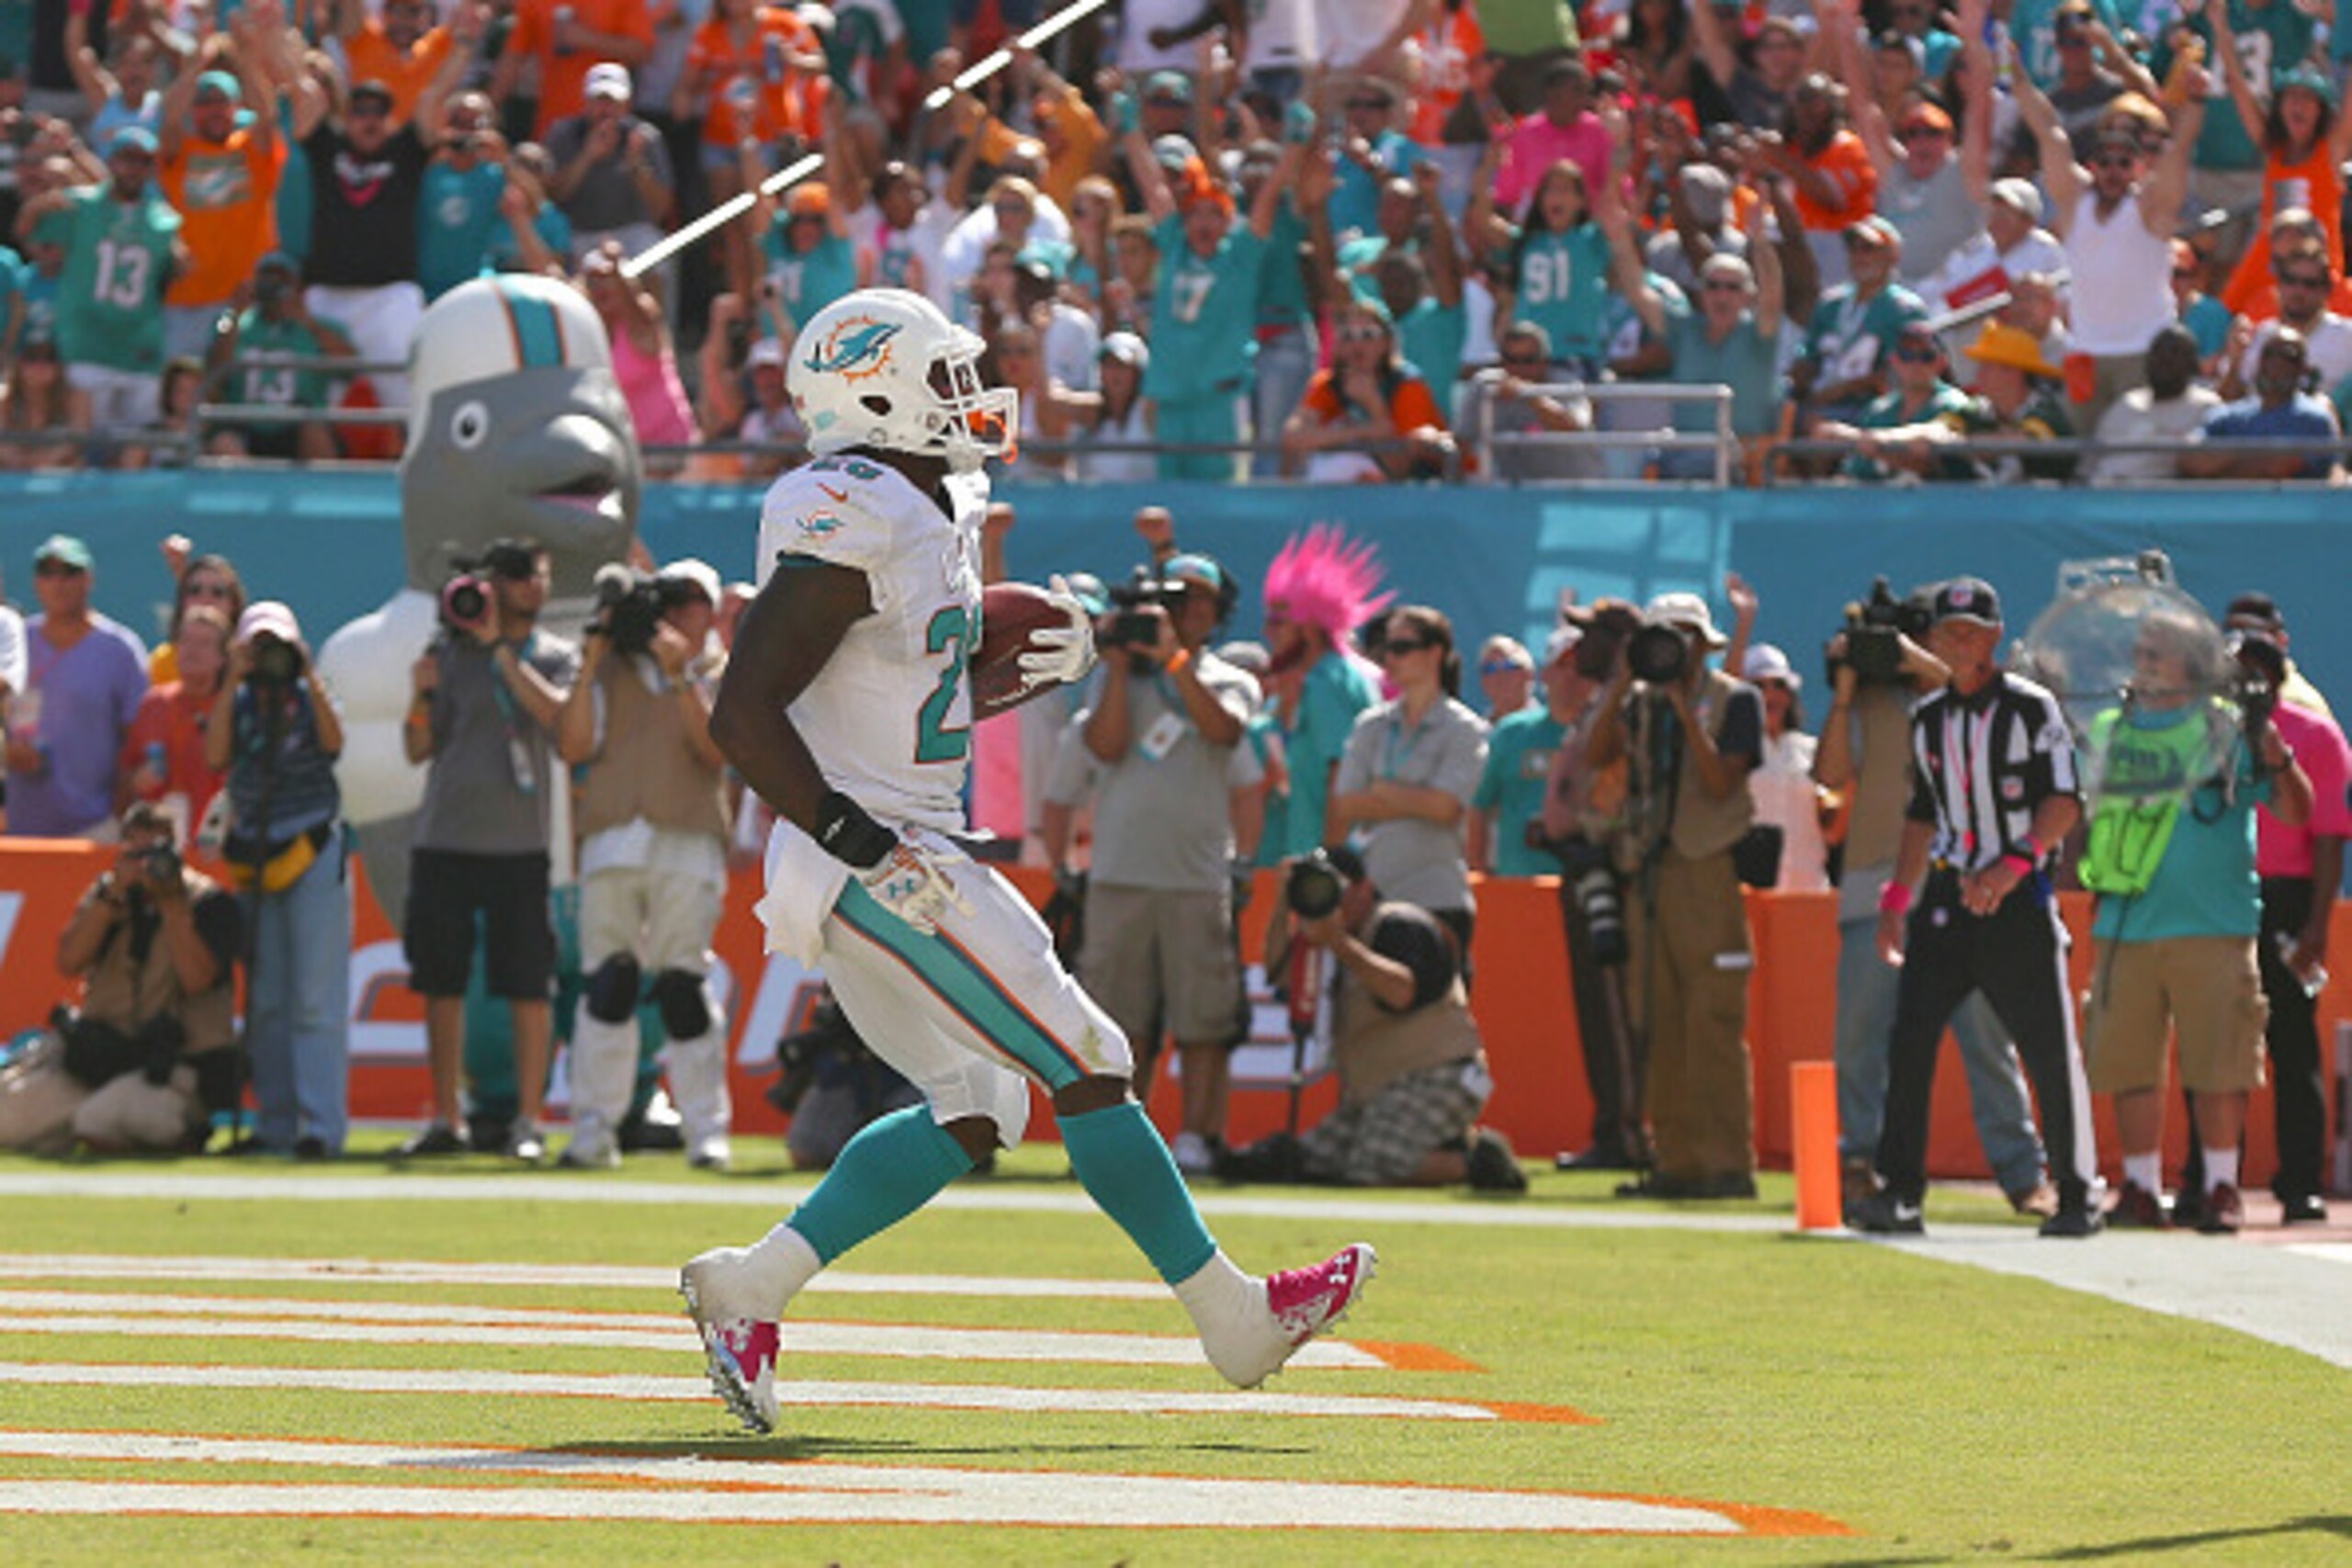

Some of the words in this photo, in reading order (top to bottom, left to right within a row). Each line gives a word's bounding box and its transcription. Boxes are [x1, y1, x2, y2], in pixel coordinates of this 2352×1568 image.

[94, 240, 151, 310] 13
[1523, 249, 1570, 303] 91
[913, 603, 983, 765] 2
